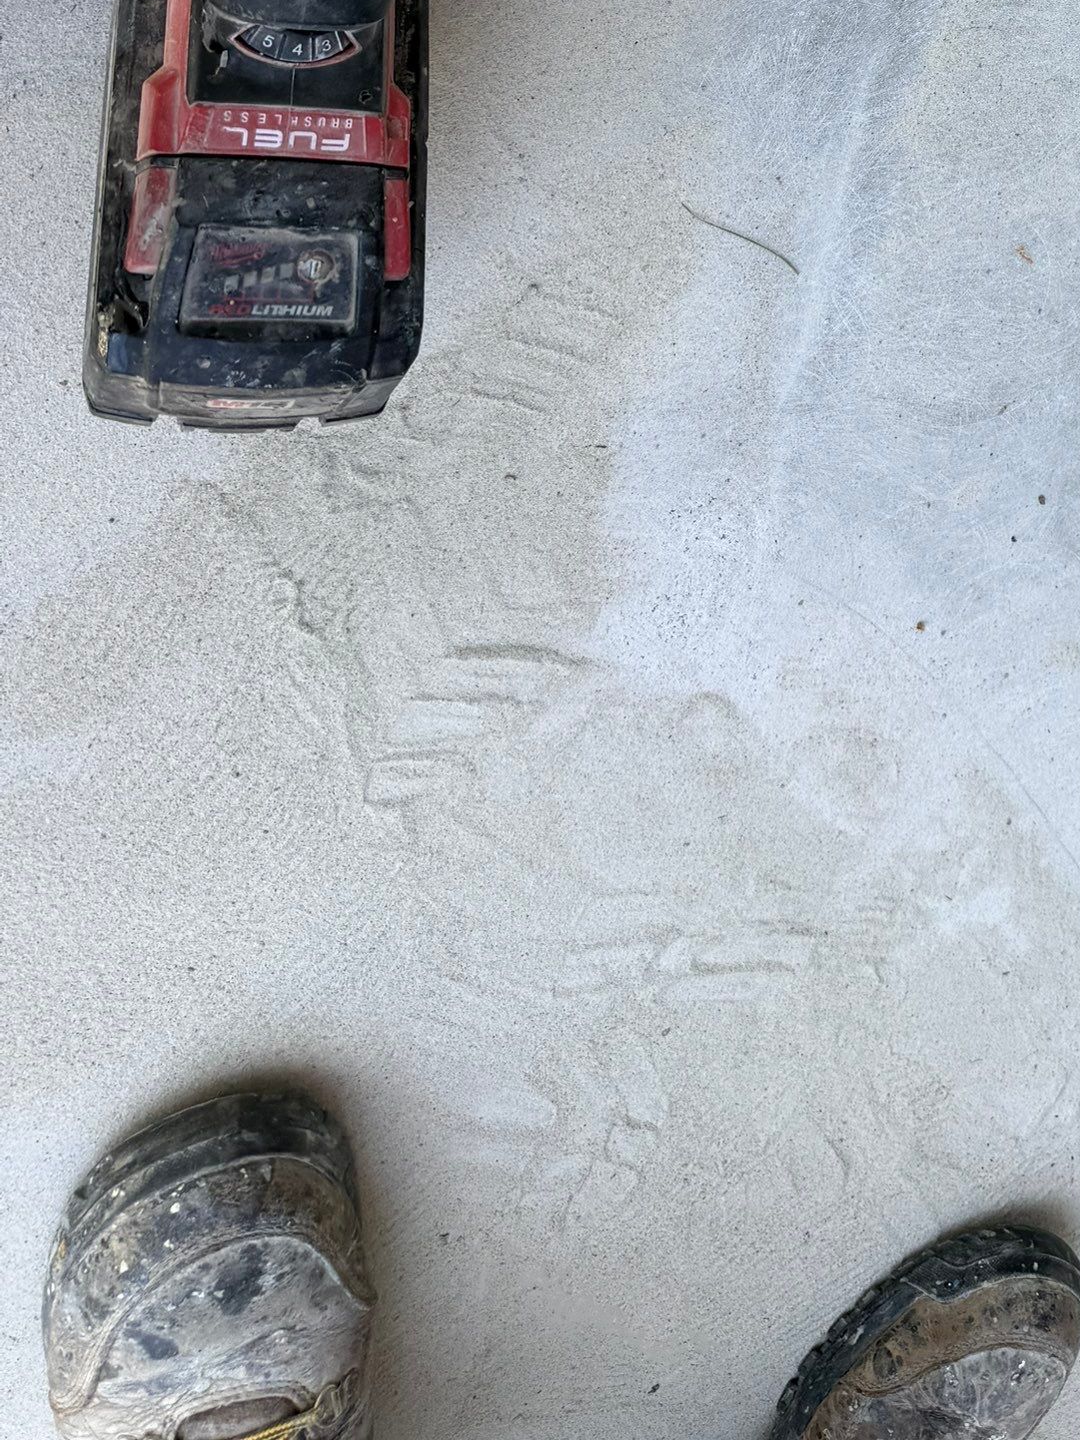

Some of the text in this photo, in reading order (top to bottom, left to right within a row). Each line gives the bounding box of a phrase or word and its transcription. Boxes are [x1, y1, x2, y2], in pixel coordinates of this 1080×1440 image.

[262, 34, 332, 56] 5 4 3
[222, 110, 354, 129] BRUSHLESS
[222, 126, 351, 152] FUEL
